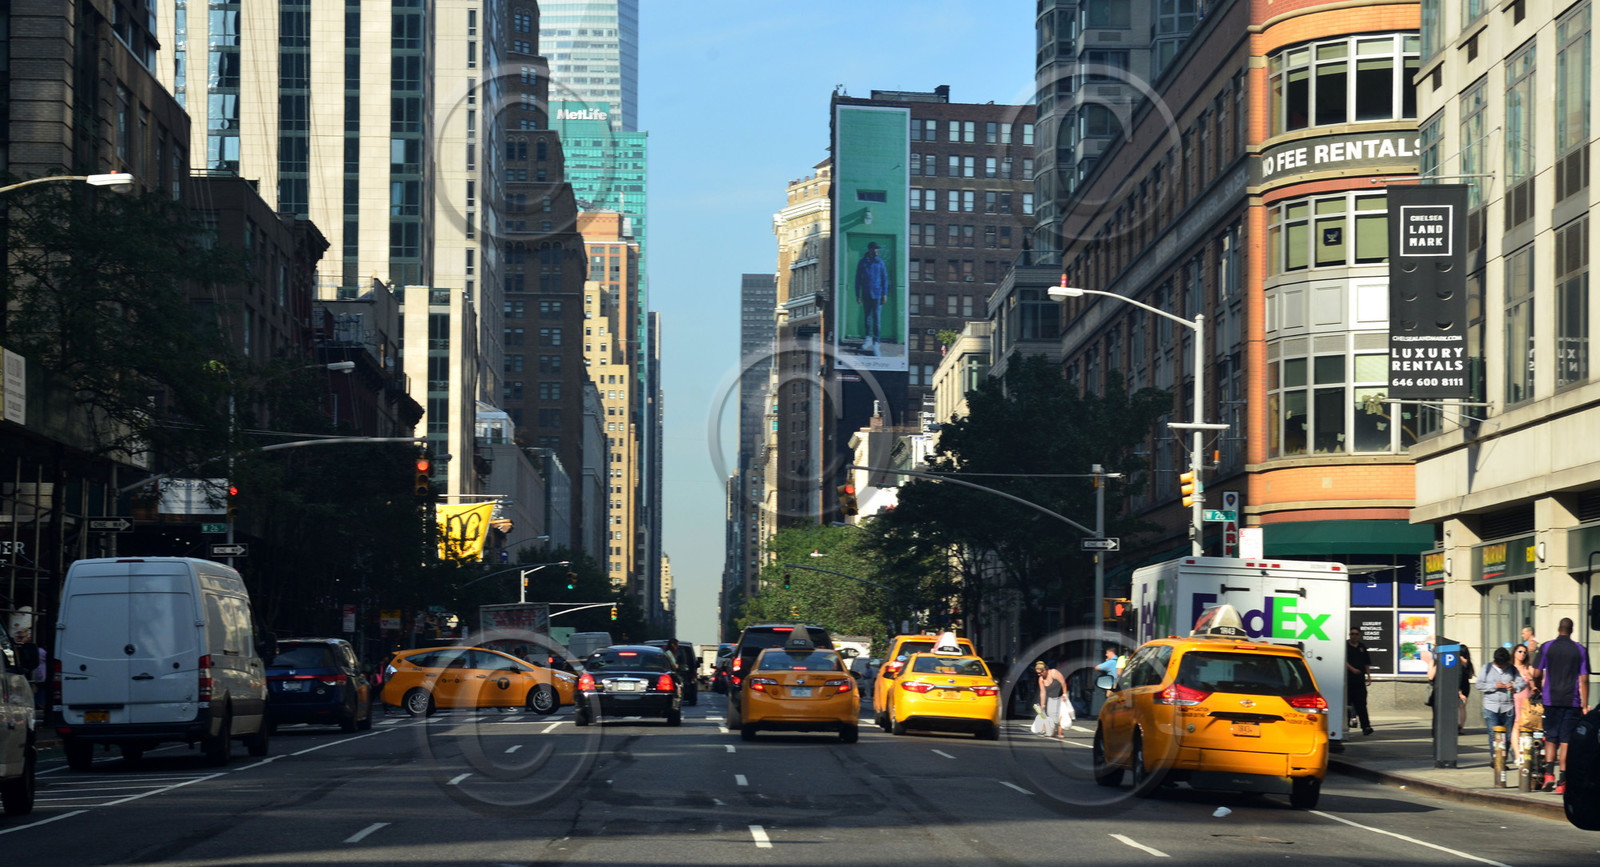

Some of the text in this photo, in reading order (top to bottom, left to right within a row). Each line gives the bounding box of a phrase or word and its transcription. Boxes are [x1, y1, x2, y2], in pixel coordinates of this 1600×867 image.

[556, 107, 608, 121] MetLife
[1262, 157, 1275, 178] NO
[1277, 147, 1308, 172] FEE
[1409, 224, 1443, 234] LAND
[1409, 237, 1443, 247] MARK
[1391, 347, 1464, 359] LUXURY
[1391, 360, 1464, 371] RENTALS
[1392, 377, 1464, 387] 646 600 8111
[1205, 511, 1212, 520] W
[1215, 511, 1225, 520] 26
[1225, 521, 1237, 556] ARK
[1192, 592, 1331, 642] FdEx
[1445, 654, 1455, 665] P
